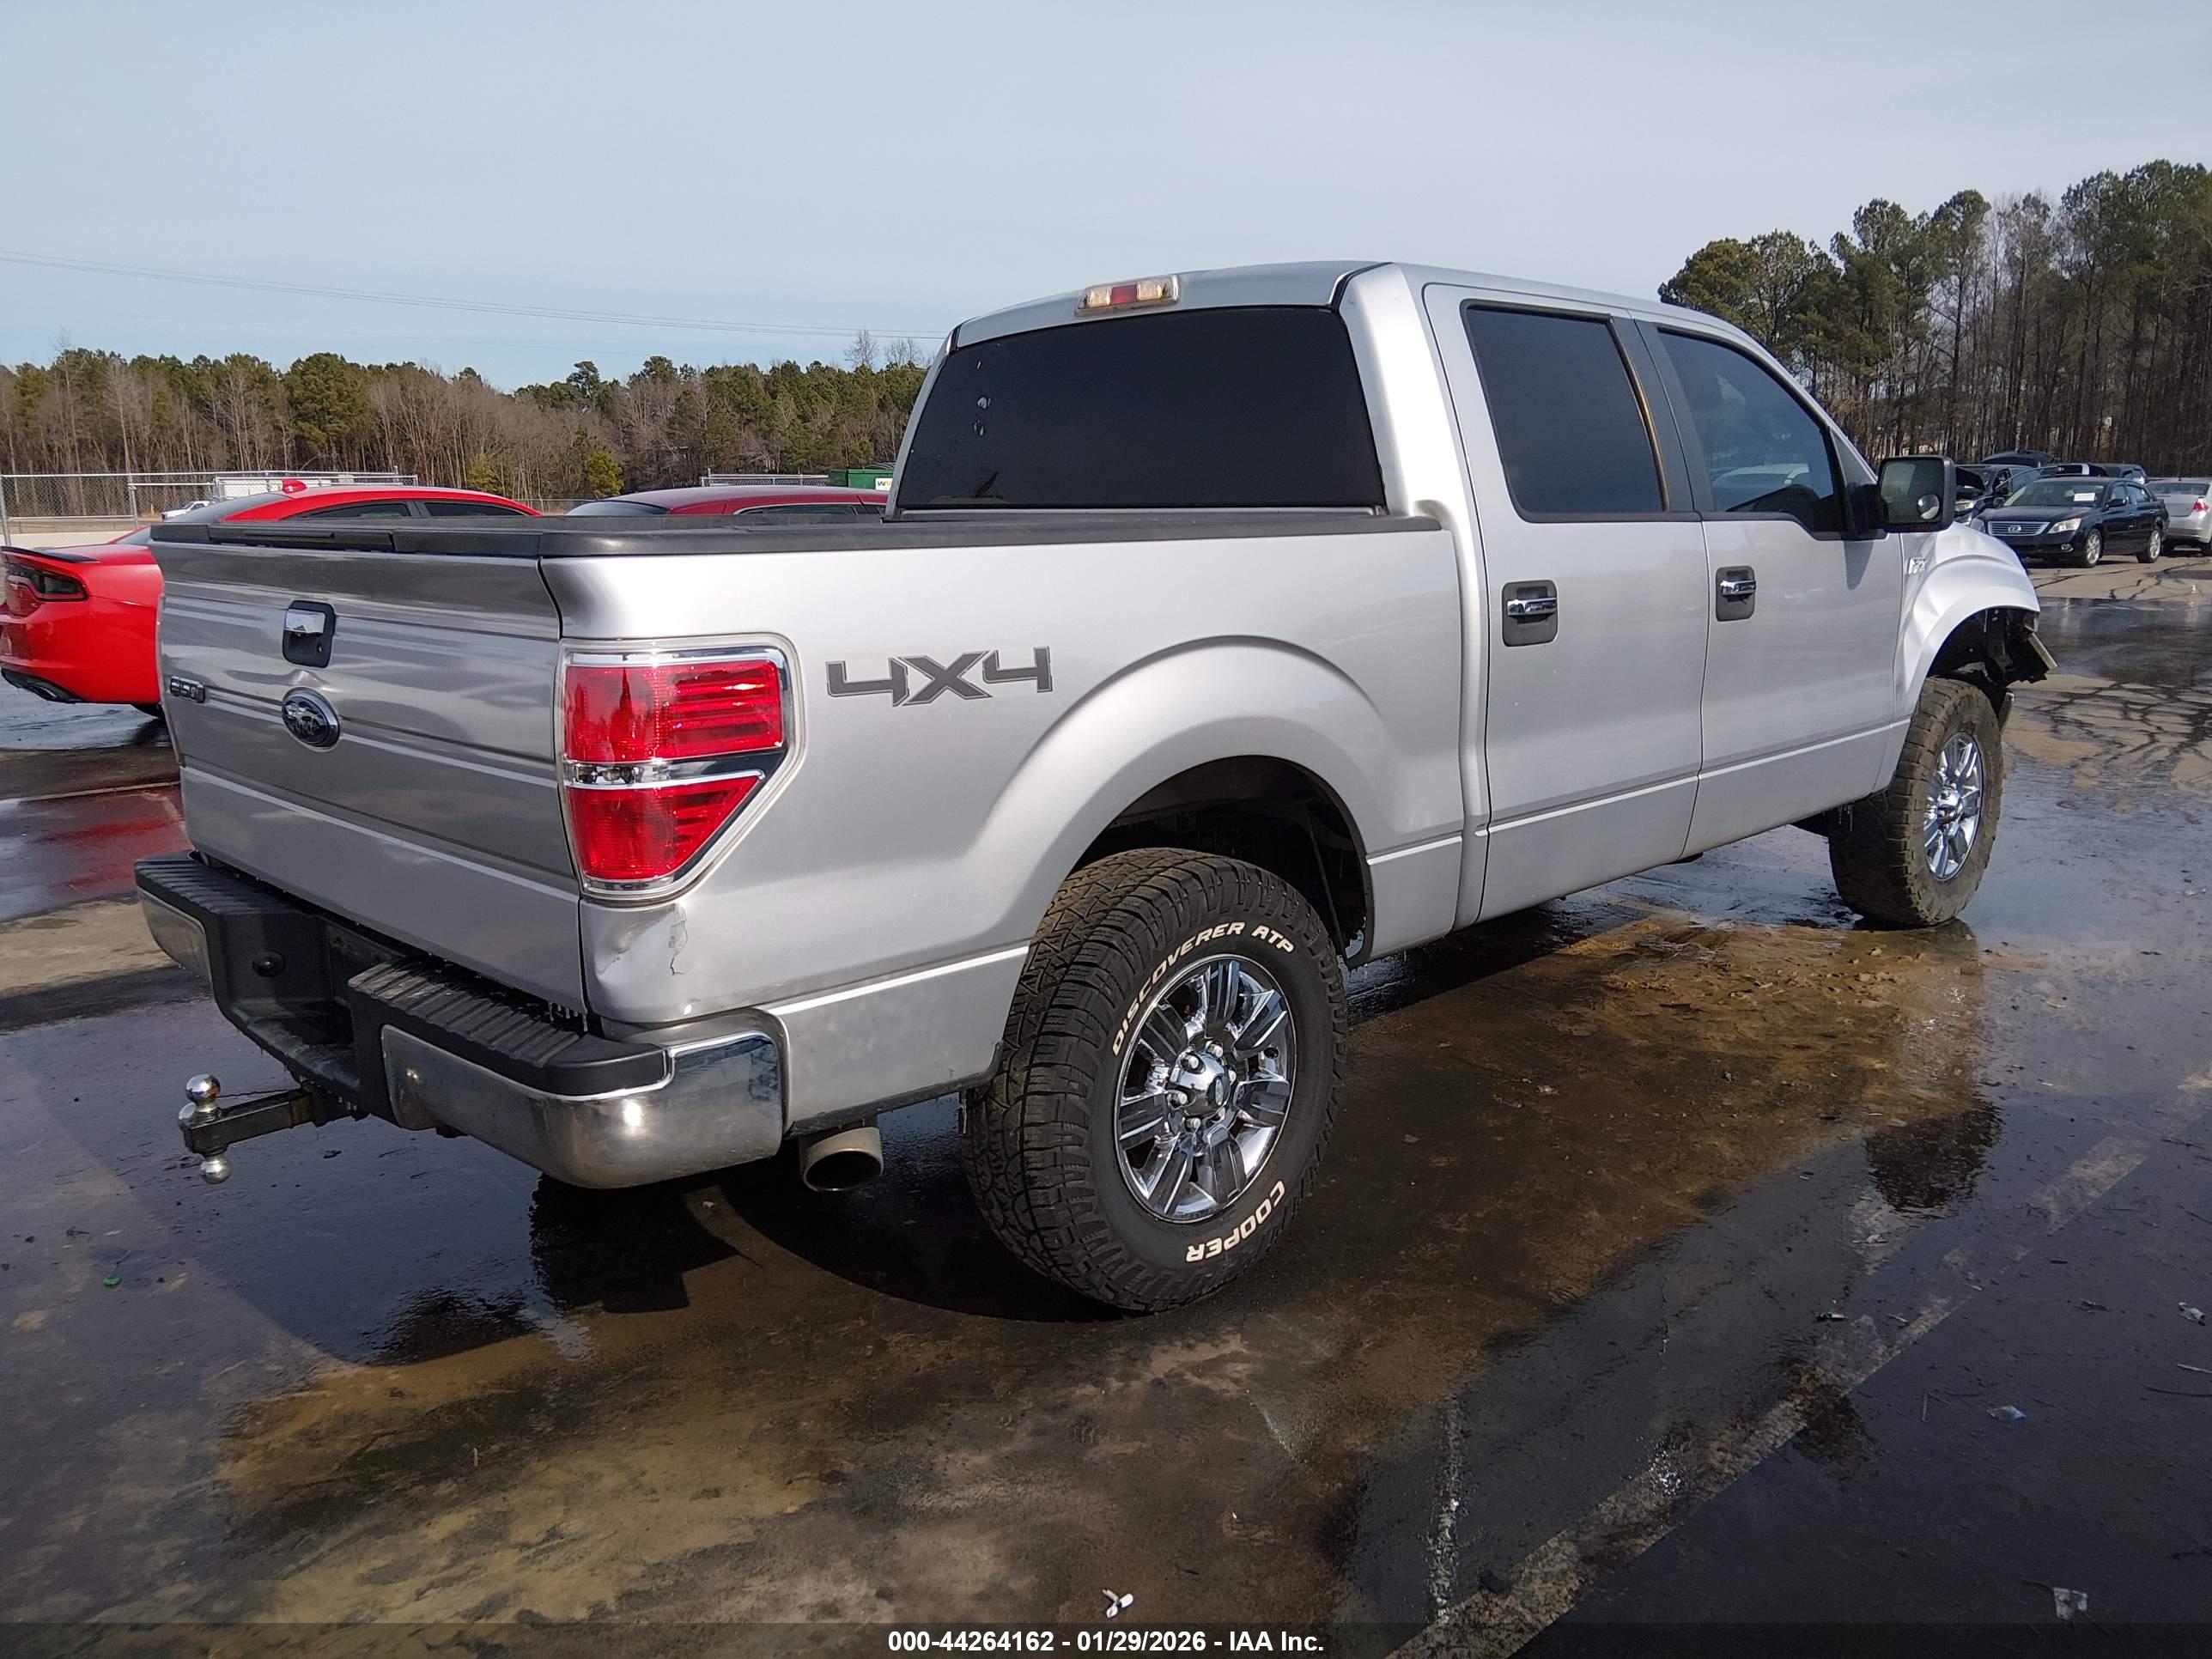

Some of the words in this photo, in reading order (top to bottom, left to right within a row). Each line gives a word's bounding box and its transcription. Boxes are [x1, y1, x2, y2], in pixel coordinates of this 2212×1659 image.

[1112, 921, 1245, 1056] DISCOVERER
[1251, 925, 1295, 953] ATP
[1185, 1180, 1285, 1262] COOPER
